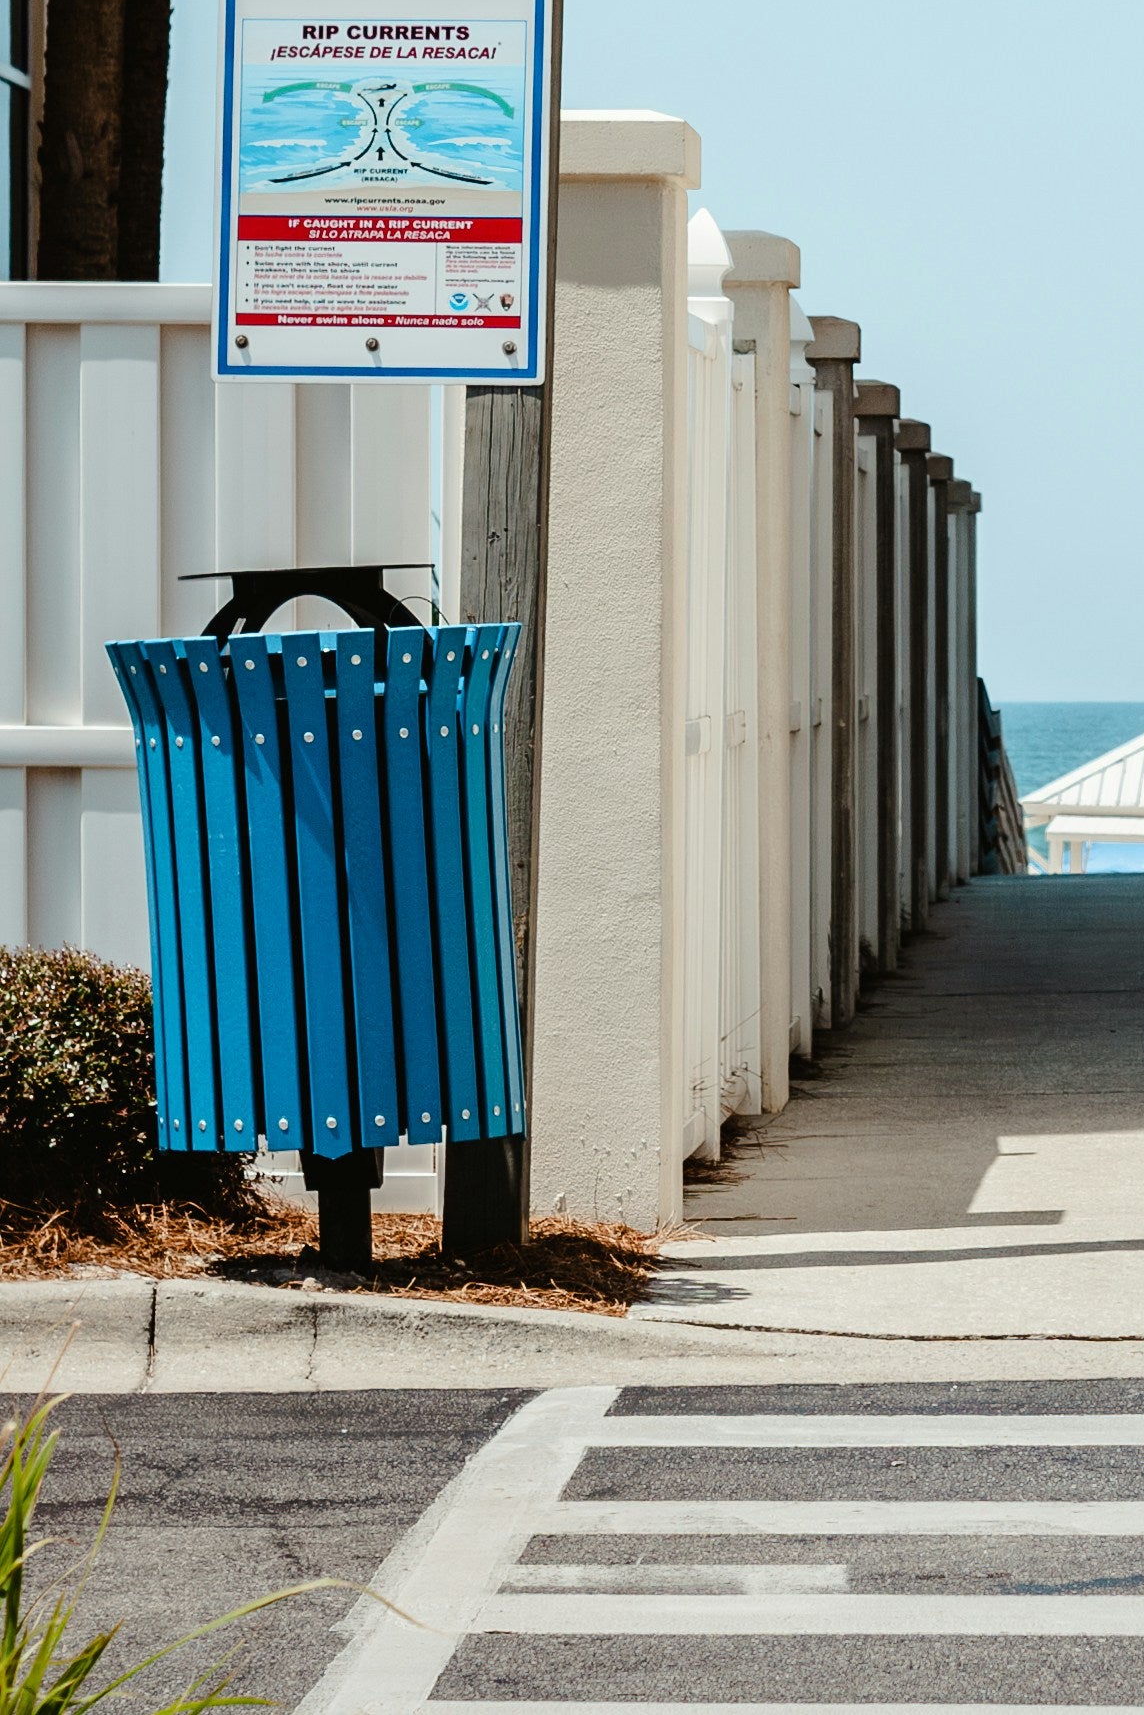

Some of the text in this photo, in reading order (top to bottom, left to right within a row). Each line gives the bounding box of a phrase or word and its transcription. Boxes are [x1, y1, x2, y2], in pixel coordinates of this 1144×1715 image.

[302, 25, 469, 40] RIP CURRENTS
[270, 43, 496, 61] ¡ESCÁPESE DE LA RESACA!
[324, 197, 445, 206] www.ripcurrents.noaa.gov
[288, 218, 473, 230] IF CAUGHT IN A RIP CURRENT
[308, 229, 450, 242] SI LO ATRAPA LA RESACA
[277, 314, 313, 326] Never
[315, 315, 348, 327] swim
[350, 315, 384, 327] alone
[395, 315, 429, 327] Nunca
[431, 315, 458, 327] nade
[460, 316, 484, 327] solo
